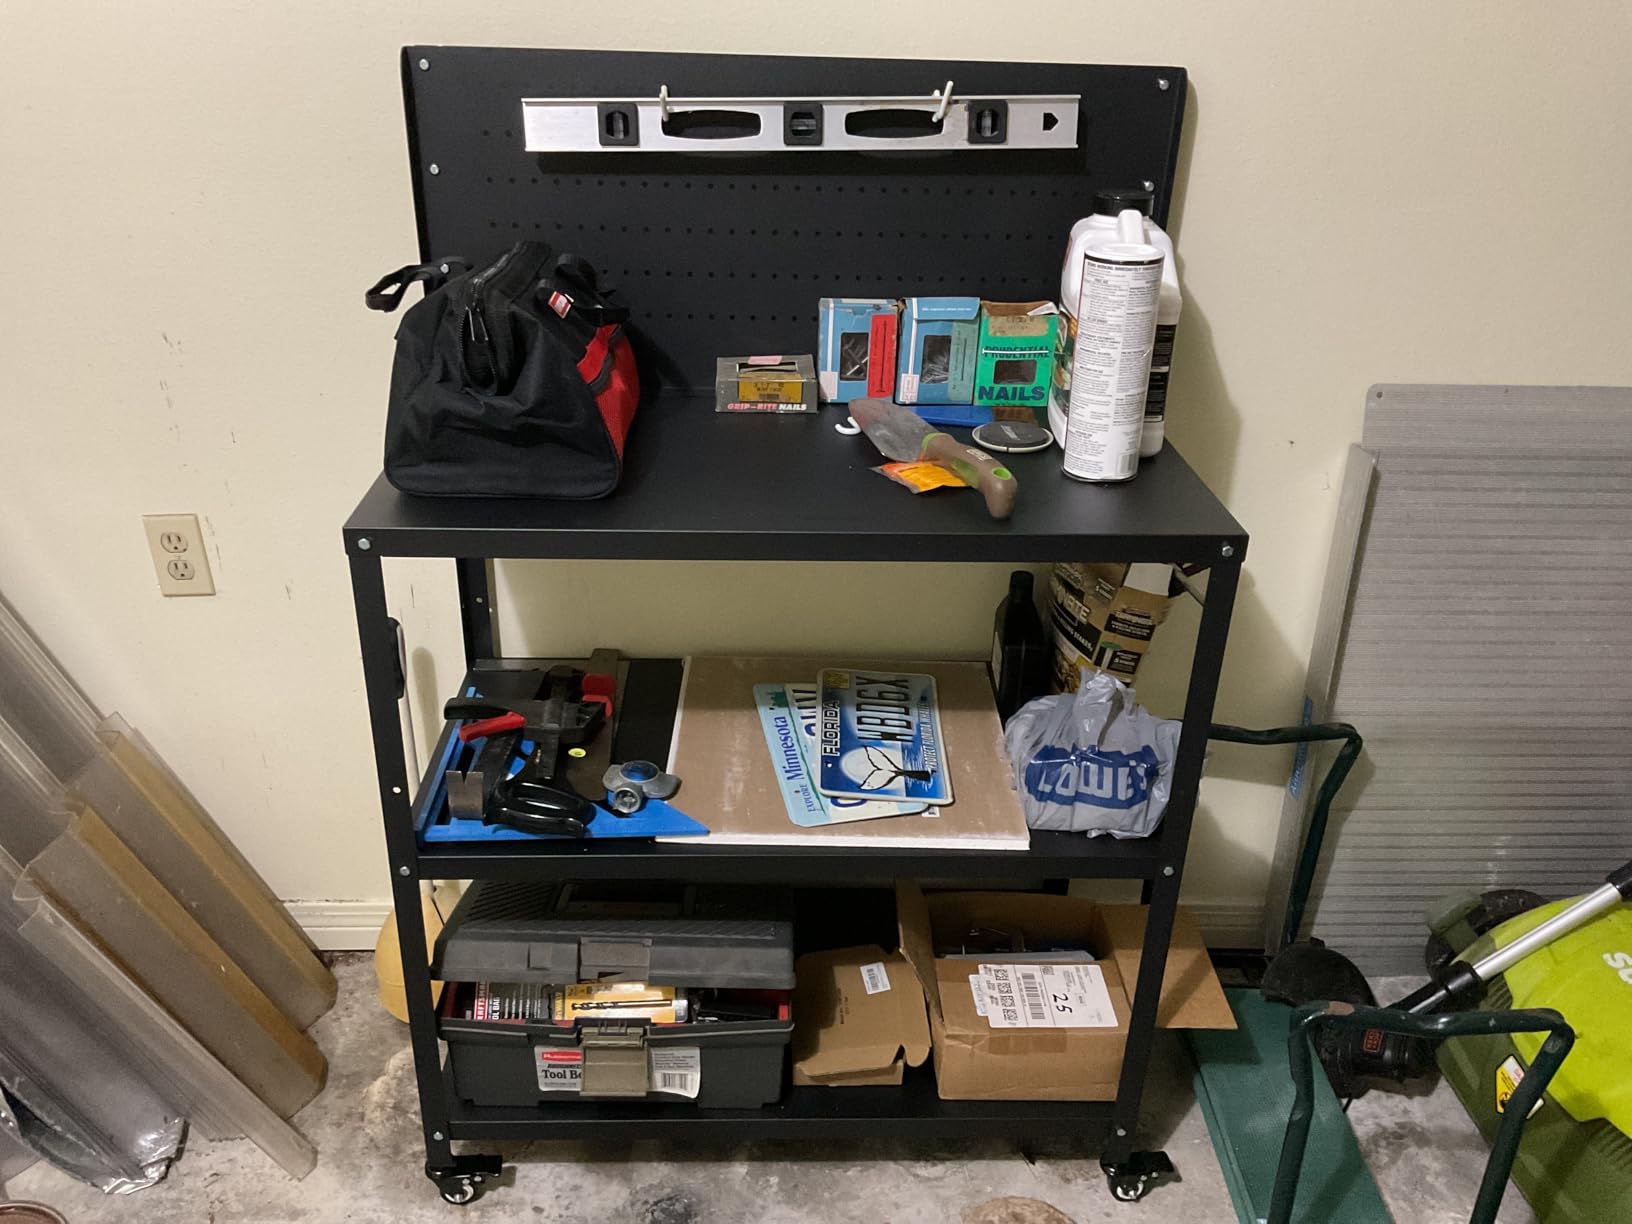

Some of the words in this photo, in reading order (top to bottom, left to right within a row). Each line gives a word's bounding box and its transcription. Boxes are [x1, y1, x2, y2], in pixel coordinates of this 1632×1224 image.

[984, 344, 1050, 359] PRUDENTIAL
[978, 385, 1046, 401] NAILS
[727, 402, 778, 411] GRIP-RITE
[778, 403, 807, 411] NAILS
[822, 700, 841, 756] FLORIDA
[920, 723, 936, 745] FLORIDA
[773, 716, 805, 781] Minnesota
[921, 745, 938, 770] PROTECT
[800, 783, 817, 813] EXPLORE
[1052, 993, 1073, 1014] 25
[541, 1069, 567, 1079] Tool
[570, 1069, 582, 1079] B
